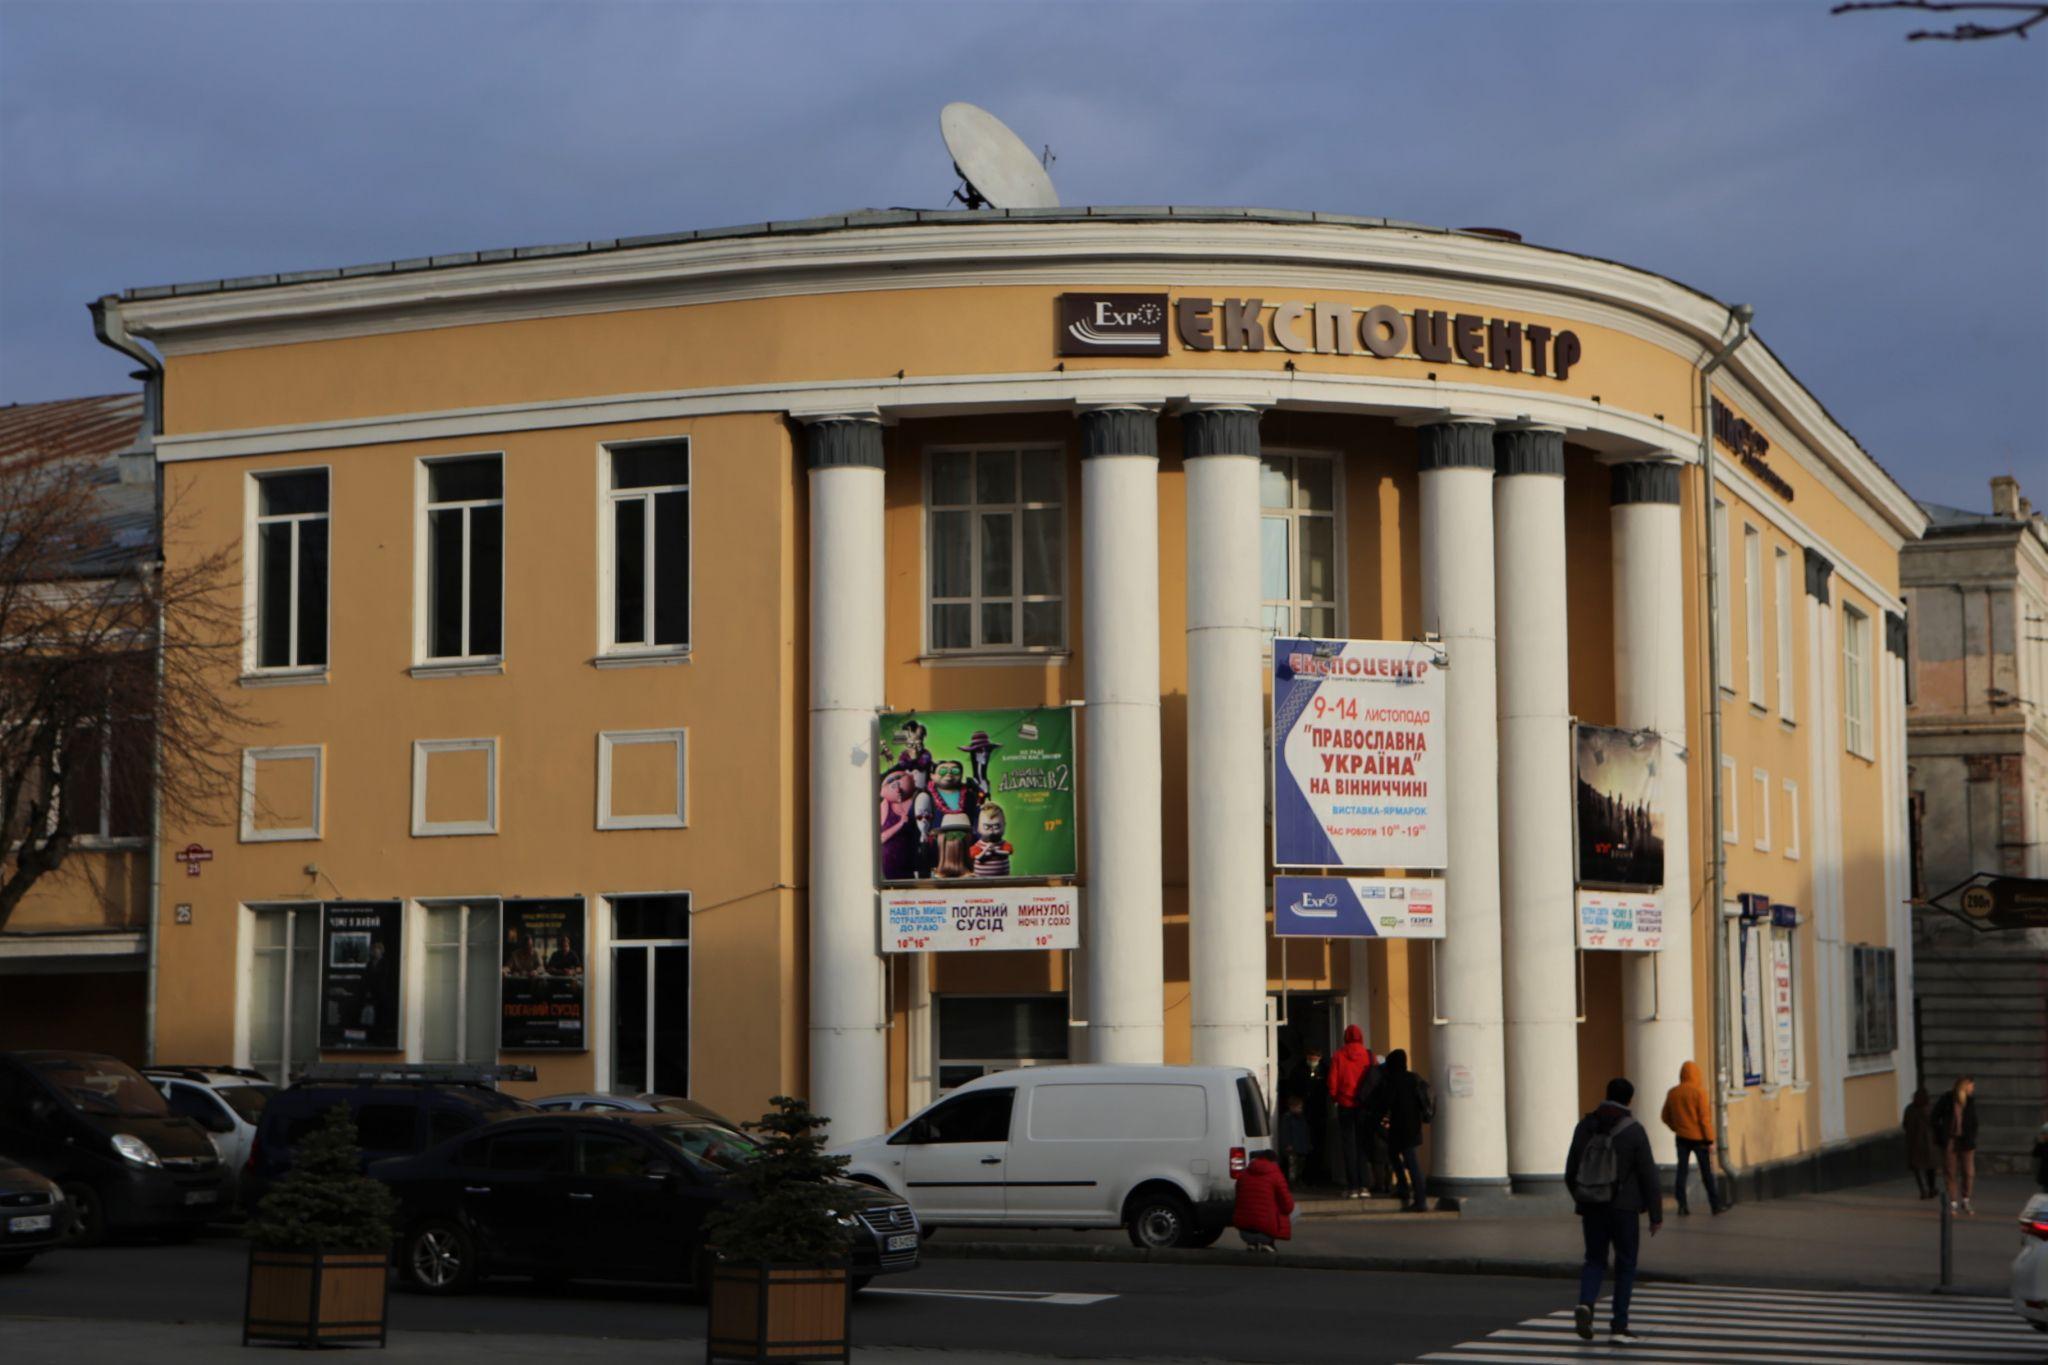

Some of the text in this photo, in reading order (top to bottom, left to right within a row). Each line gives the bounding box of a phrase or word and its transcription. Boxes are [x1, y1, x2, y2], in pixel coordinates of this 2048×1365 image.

[1177, 297, 1582, 381] ЕКСПОЦЕНТР
[1288, 652, 1428, 678] ЕКСПОЦЕНТР
[1313, 696, 1358, 720] 9-14
[1056, 763, 1070, 792] 2
[1310, 777, 1427, 797] НА ВІННИЧЧИНІ
[1332, 805, 1427, 816] ВИСТАВКА-ЯРМАРОК
[952, 902, 1008, 918] ПОГАНИЙ
[1018, 901, 1070, 917] МИНУЛОЇ
[956, 918, 1004, 932] СУСІД
[1018, 918, 1039, 927] НОЧІ
[1047, 917, 1071, 926] СОХО
